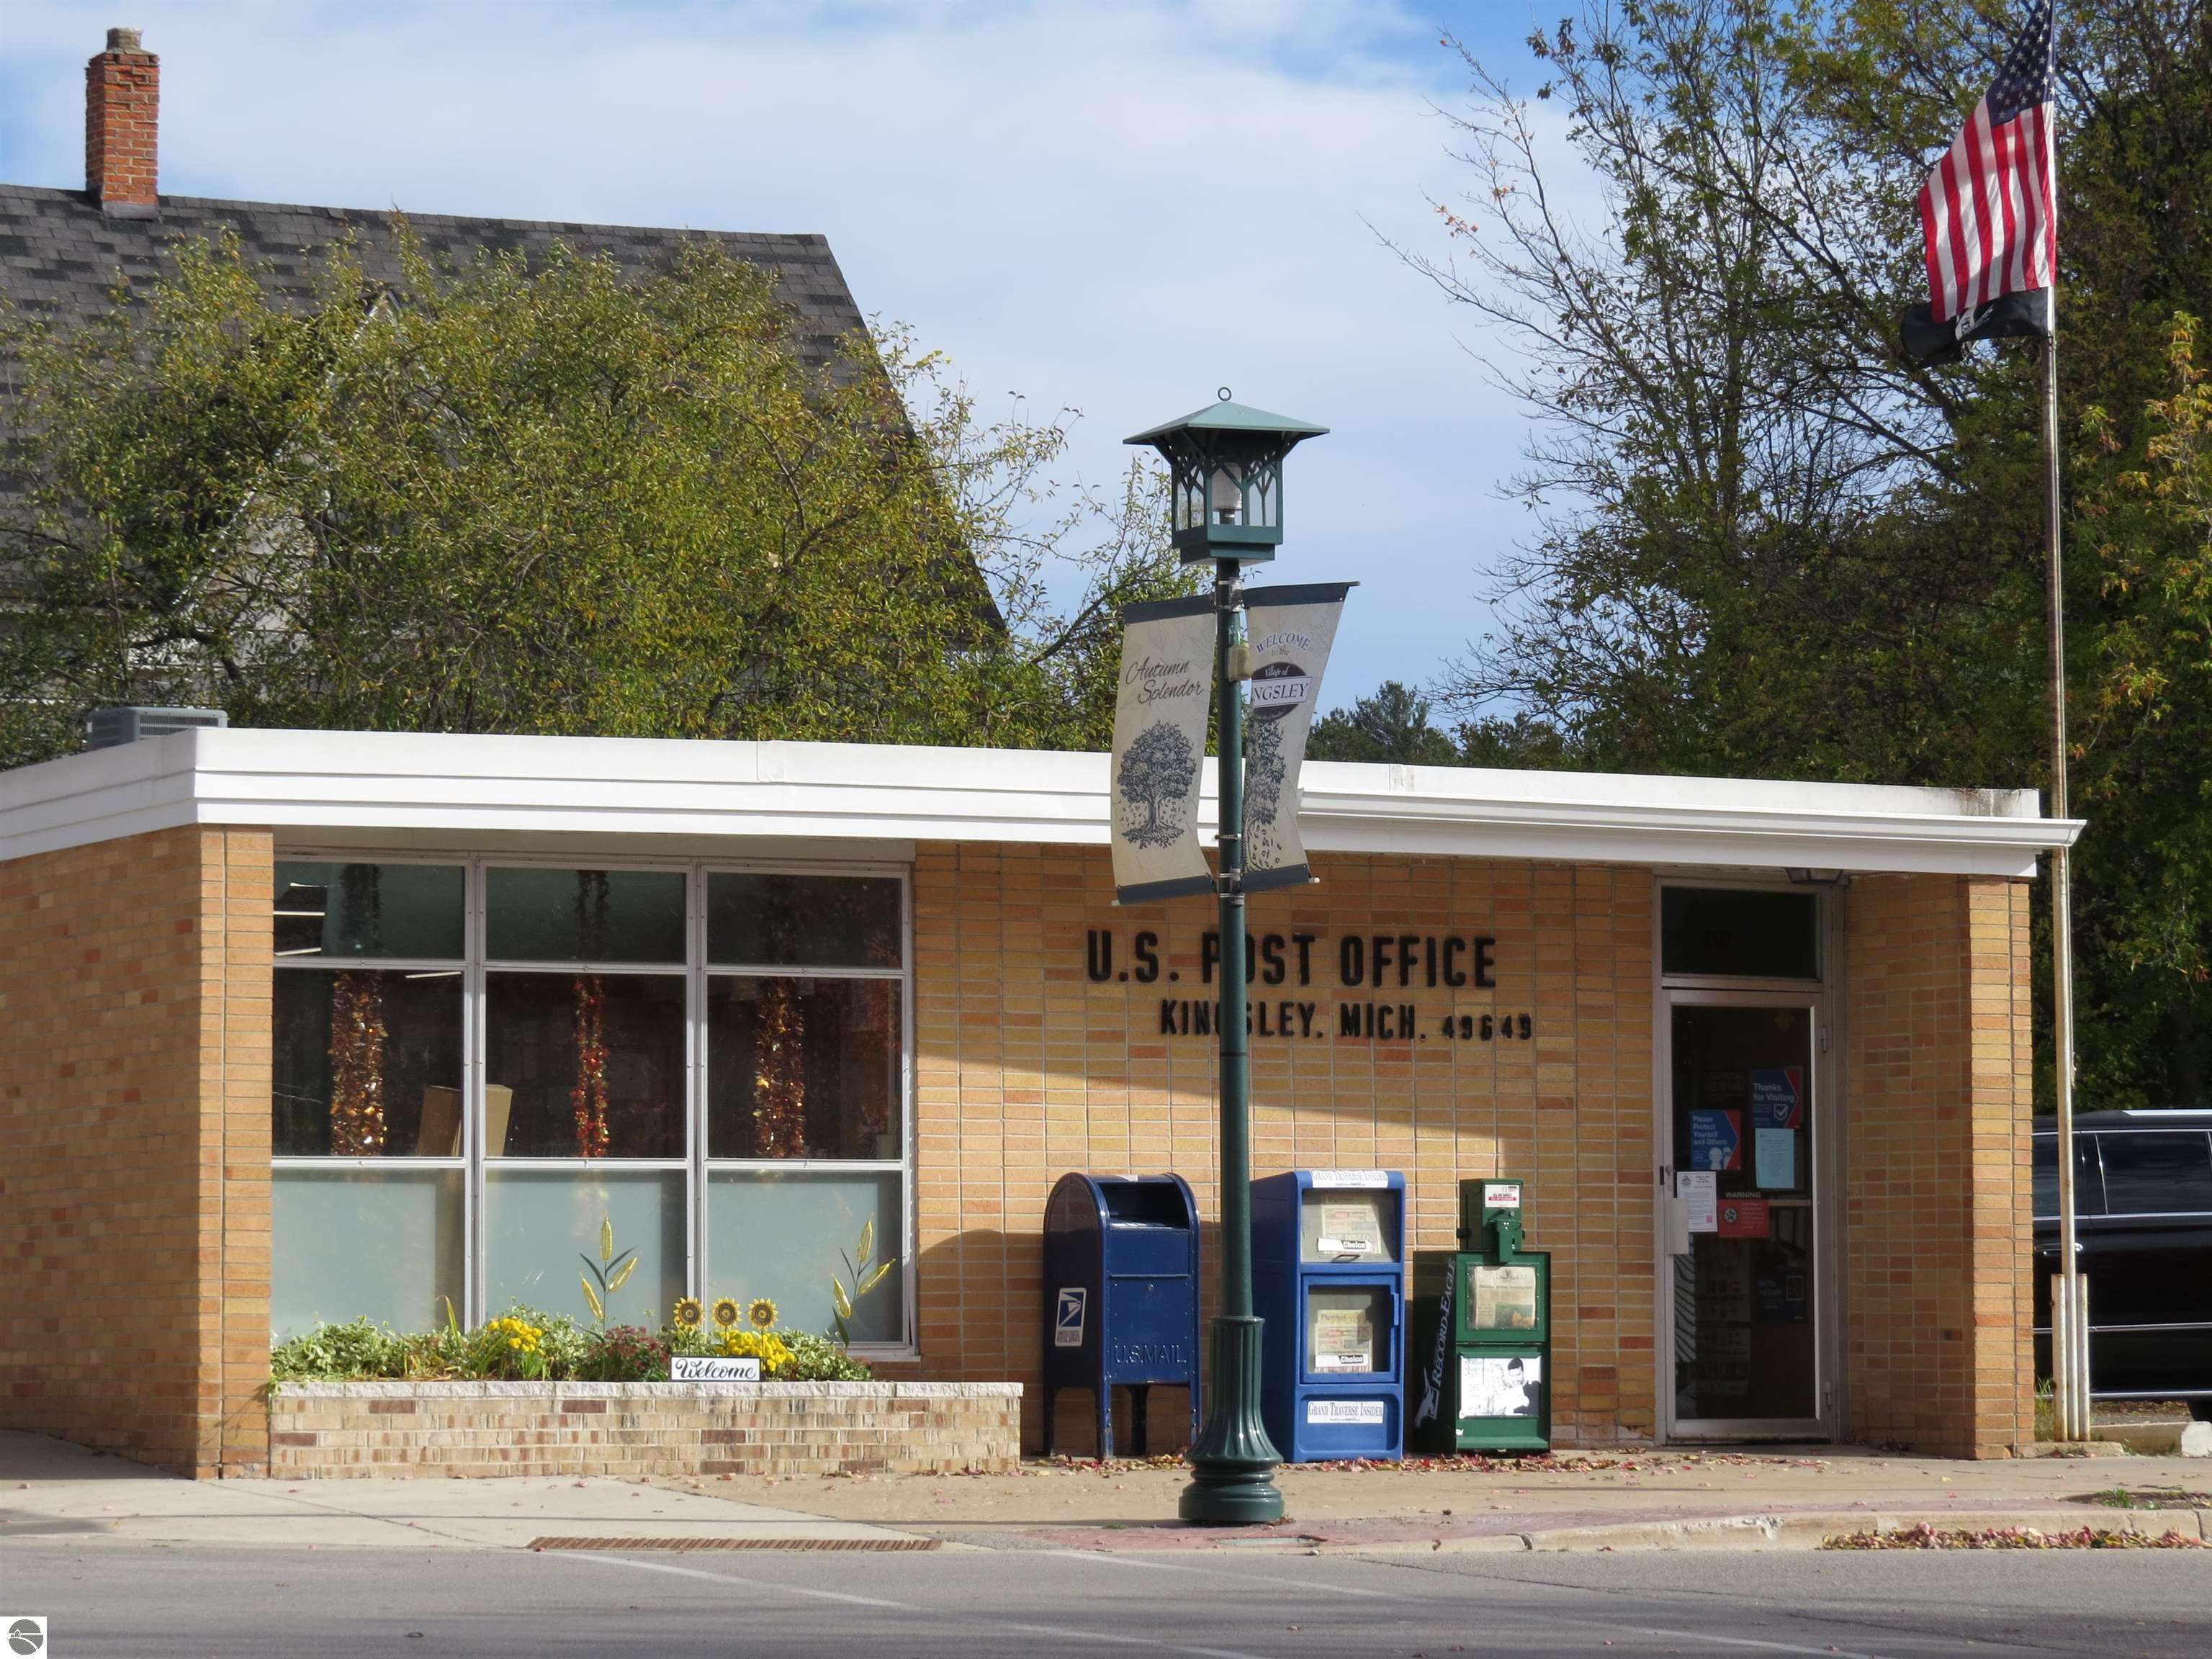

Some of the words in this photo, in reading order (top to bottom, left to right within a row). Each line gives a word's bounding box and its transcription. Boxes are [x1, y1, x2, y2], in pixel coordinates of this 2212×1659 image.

[1256, 632, 1311, 652] WELCOME
[1125, 656, 1190, 685] Autumn
[1137, 679, 1204, 706] Splendor
[1254, 683, 1308, 701] NGSLEY
[1088, 930, 1179, 983] U.S.
[1340, 935, 1496, 988] OFFICE
[1340, 1002, 1426, 1040] MICH.
[1442, 1012, 1532, 1040] 49649
[1753, 1083, 1782, 1092] Thanks
[1766, 1093, 1795, 1103] Visiting
[1432, 1257, 1456, 1386] RECORD-EAGLE
[1143, 1344, 1187, 1364] MAIL
[675, 1358, 757, 1380] Welcome
[1308, 1402, 1328, 1416] GRAND
[1329, 1402, 1359, 1416] TRAVERSE
[1359, 1402, 1383, 1416] INSIDER
